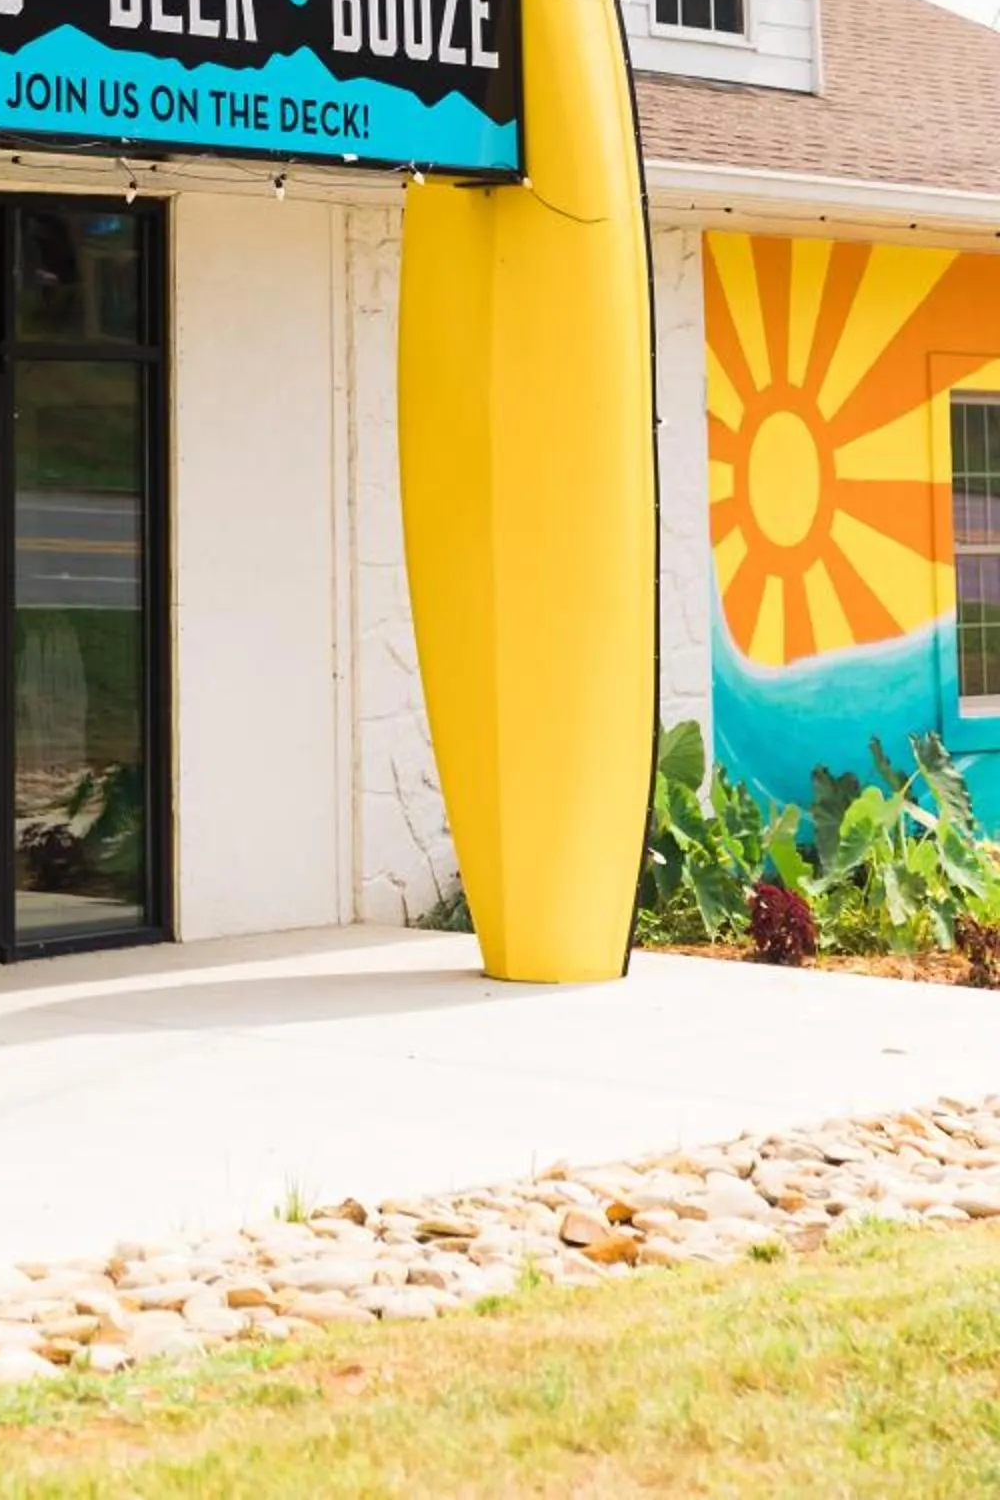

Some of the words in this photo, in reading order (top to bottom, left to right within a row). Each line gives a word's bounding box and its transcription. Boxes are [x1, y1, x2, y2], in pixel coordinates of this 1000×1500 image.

[6, 71, 88, 113] JOIN
[99, 79, 137, 119] US
[150, 85, 199, 123] ON
[209, 92, 268, 129] THE
[281, 99, 370, 139] DECK!
